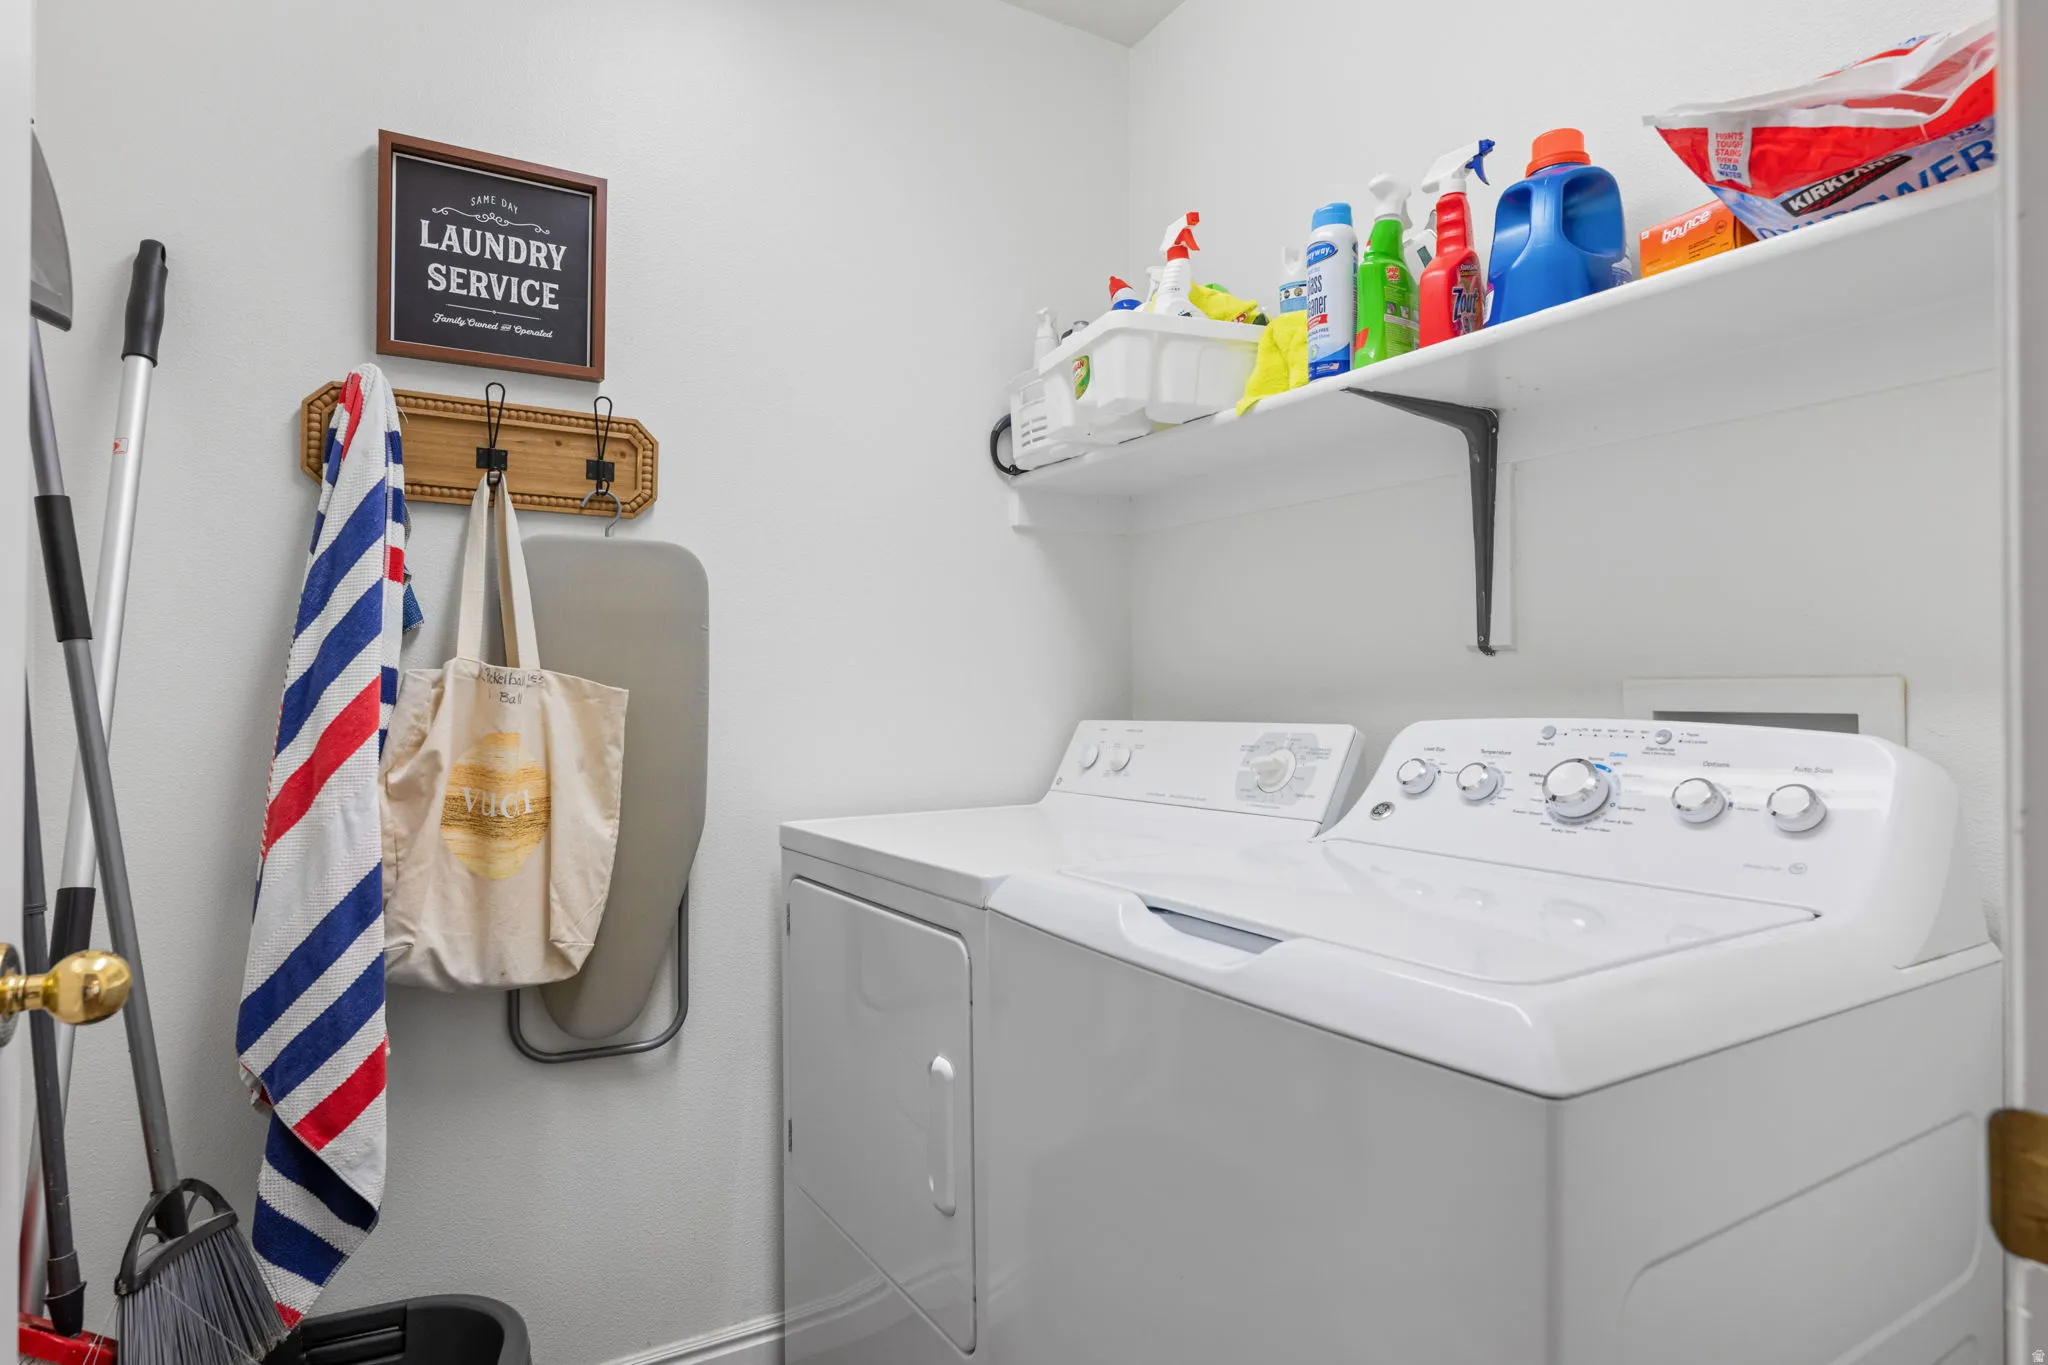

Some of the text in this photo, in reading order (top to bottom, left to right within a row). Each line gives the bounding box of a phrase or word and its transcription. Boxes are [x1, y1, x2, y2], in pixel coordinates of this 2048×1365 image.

[1716, 140, 1743, 148] TOUGH
[1788, 154, 1900, 211] KIRKLAND
[471, 195, 519, 214] SAME DAY
[1662, 210, 1711, 244] bounce
[419, 218, 568, 271] LAUNDRY
[427, 262, 560, 310] SERVICE
[1453, 287, 1479, 322] Zout
[433, 312, 466, 326] Family
[466, 318, 499, 330] Owned
[513, 325, 553, 338] Operated
[1703, 760, 1730, 768] Options
